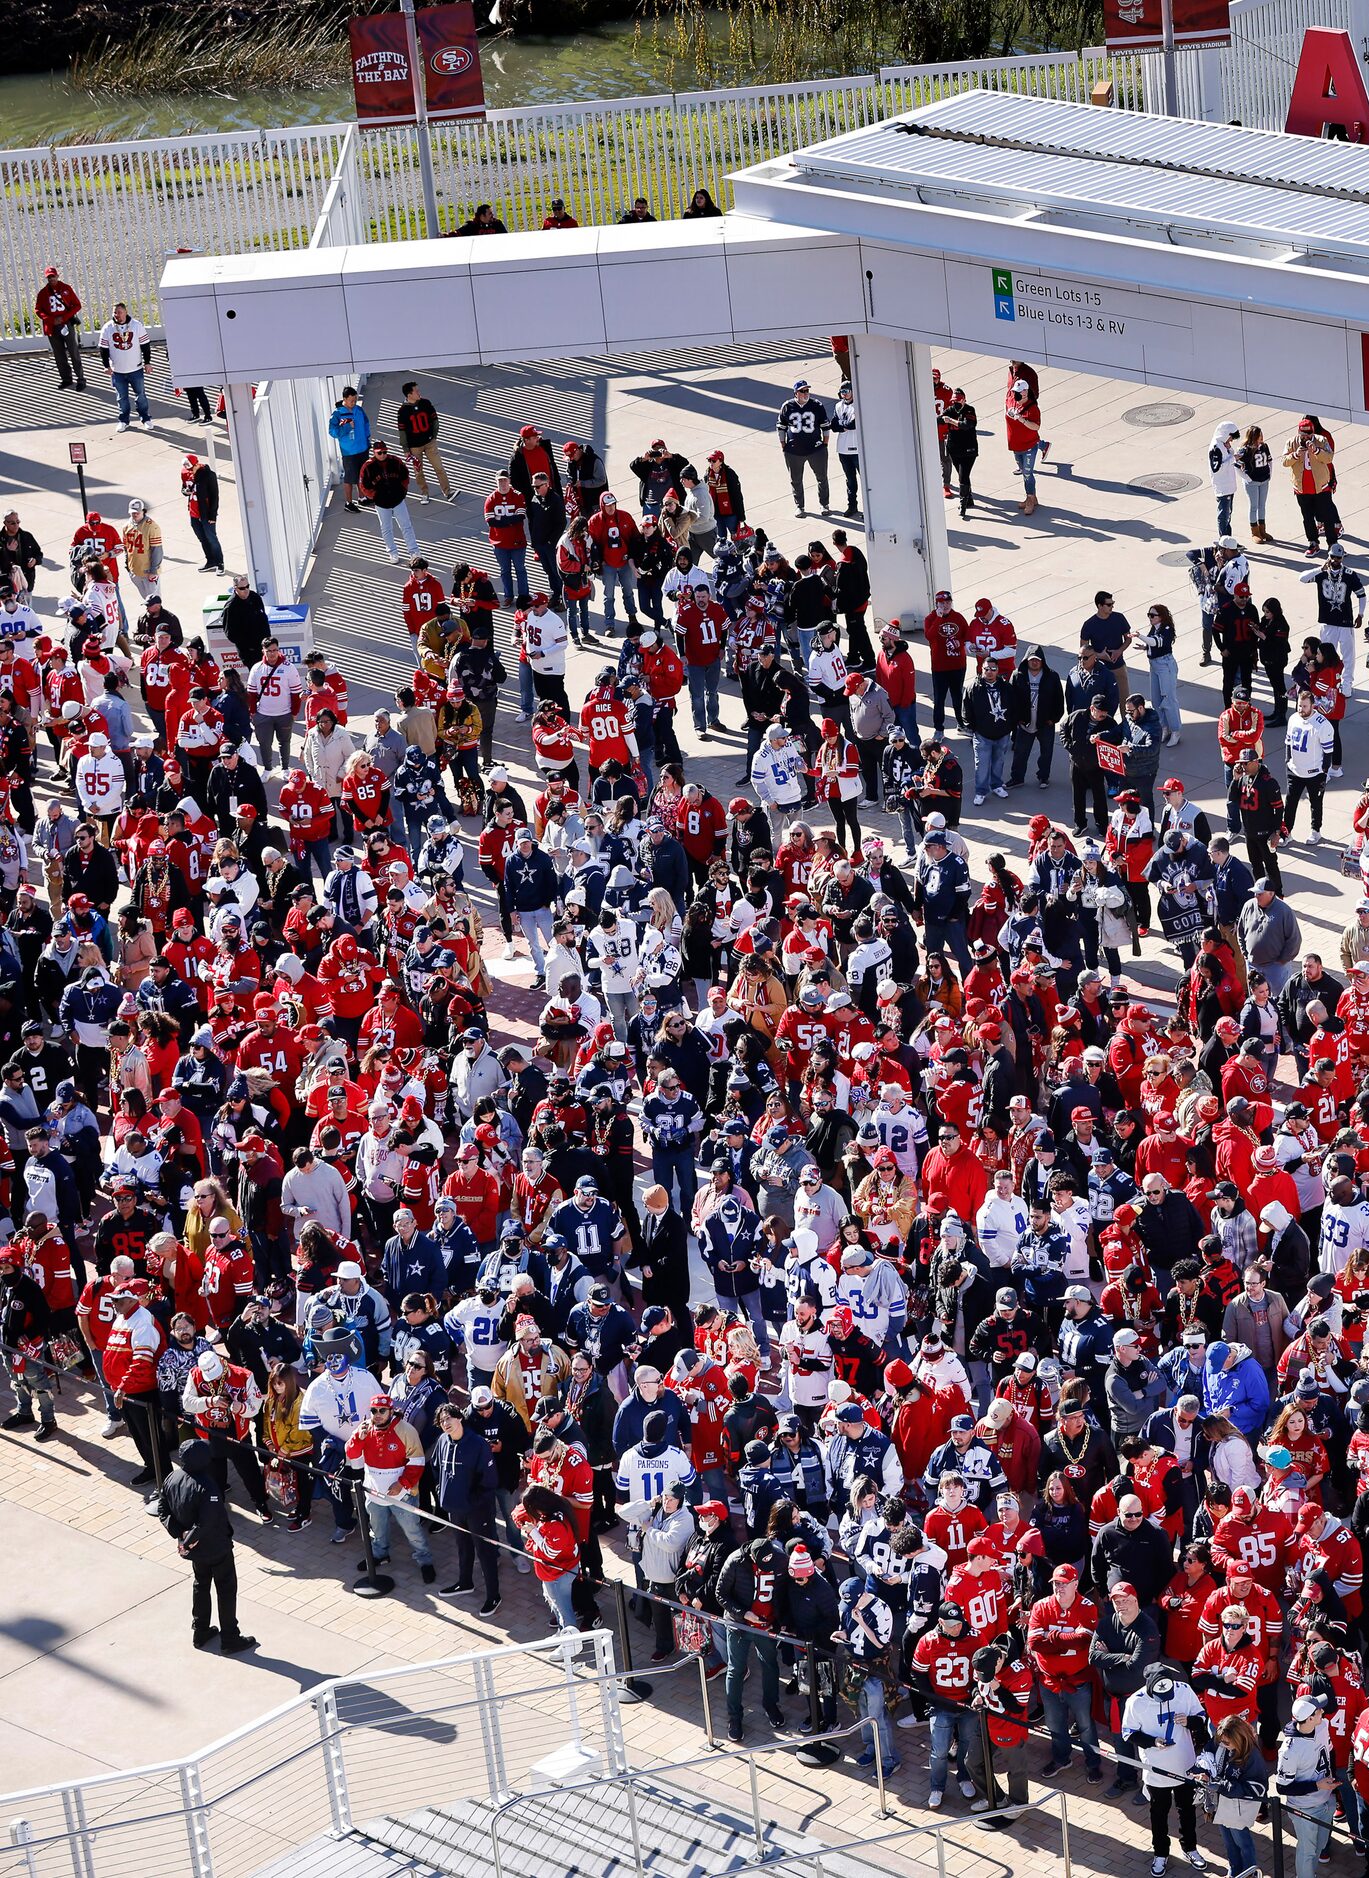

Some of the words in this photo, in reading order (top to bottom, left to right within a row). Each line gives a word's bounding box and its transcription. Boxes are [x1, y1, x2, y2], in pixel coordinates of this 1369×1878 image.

[1134, 47, 1160, 55] STADIUM
[1201, 41, 1227, 49] STADIUM
[355, 51, 408, 72] FAITHFUL
[356, 70, 382, 83] THE
[384, 68, 408, 81] BAY
[387, 124, 413, 132] STADIUM
[456, 118, 483, 126] STADIUM
[1016, 279, 1051, 297] Green
[1055, 286, 1082, 302] Lots
[1085, 291, 1101, 306] 1-5
[1018, 304, 1044, 320] Blue
[1048, 309, 1074, 326] Lots
[1077, 315, 1093, 329] 1-3
[1096, 319, 1105, 332] &
[1109, 320, 1125, 335] RV
[409, 413, 428, 432] 10
[789, 412, 815, 432] 33
[1212, 461, 1218, 469] 7
[1255, 453, 1269, 466] 21
[1227, 578, 1233, 588] 8
[413, 593, 431, 611] 19
[700, 623, 716, 643] 11
[976, 636, 997, 650] 52
[145, 664, 166, 686] 85
[832, 657, 846, 681] 19
[595, 704, 611, 712] RICE
[592, 717, 619, 738] 80
[1292, 727, 1307, 751] 21
[85, 773, 109, 795] 85
[357, 786, 374, 799] 85
[688, 812, 699, 834] 8
[184, 956, 198, 975] 11
[666, 961, 678, 971] 88
[373, 1029, 394, 1048] 23
[797, 1025, 826, 1049] 52
[68, 1056, 75, 1066] 2
[260, 1051, 287, 1072] 54
[31, 1067, 47, 1090] 2
[1319, 1099, 1336, 1122] 21
[878, 1122, 907, 1151] 12
[408, 1160, 420, 1169] 10
[575, 1226, 602, 1253] 11
[1324, 1216, 1350, 1247] 33
[112, 1232, 146, 1255] 85
[230, 1249, 243, 1261] 23
[440, 1251, 452, 1268] 7
[426, 1324, 442, 1334] 88
[473, 1318, 499, 1345] 21
[997, 1334, 1027, 1357] 53
[568, 1452, 581, 1466] 23
[637, 1460, 669, 1469] PARSONS
[642, 1473, 663, 1499] 11
[791, 1463, 804, 1488] 4
[947, 1524, 967, 1549] 11
[1337, 1530, 1352, 1544] 97
[874, 1542, 905, 1575] 88
[1239, 1532, 1276, 1567] 85
[969, 1591, 997, 1629] 80
[851, 1630, 864, 1655] 4
[935, 1657, 970, 1687] 23
[1247, 1662, 1259, 1678] 16
[1157, 1713, 1174, 1747] 7
[1316, 1745, 1330, 1776] 4
